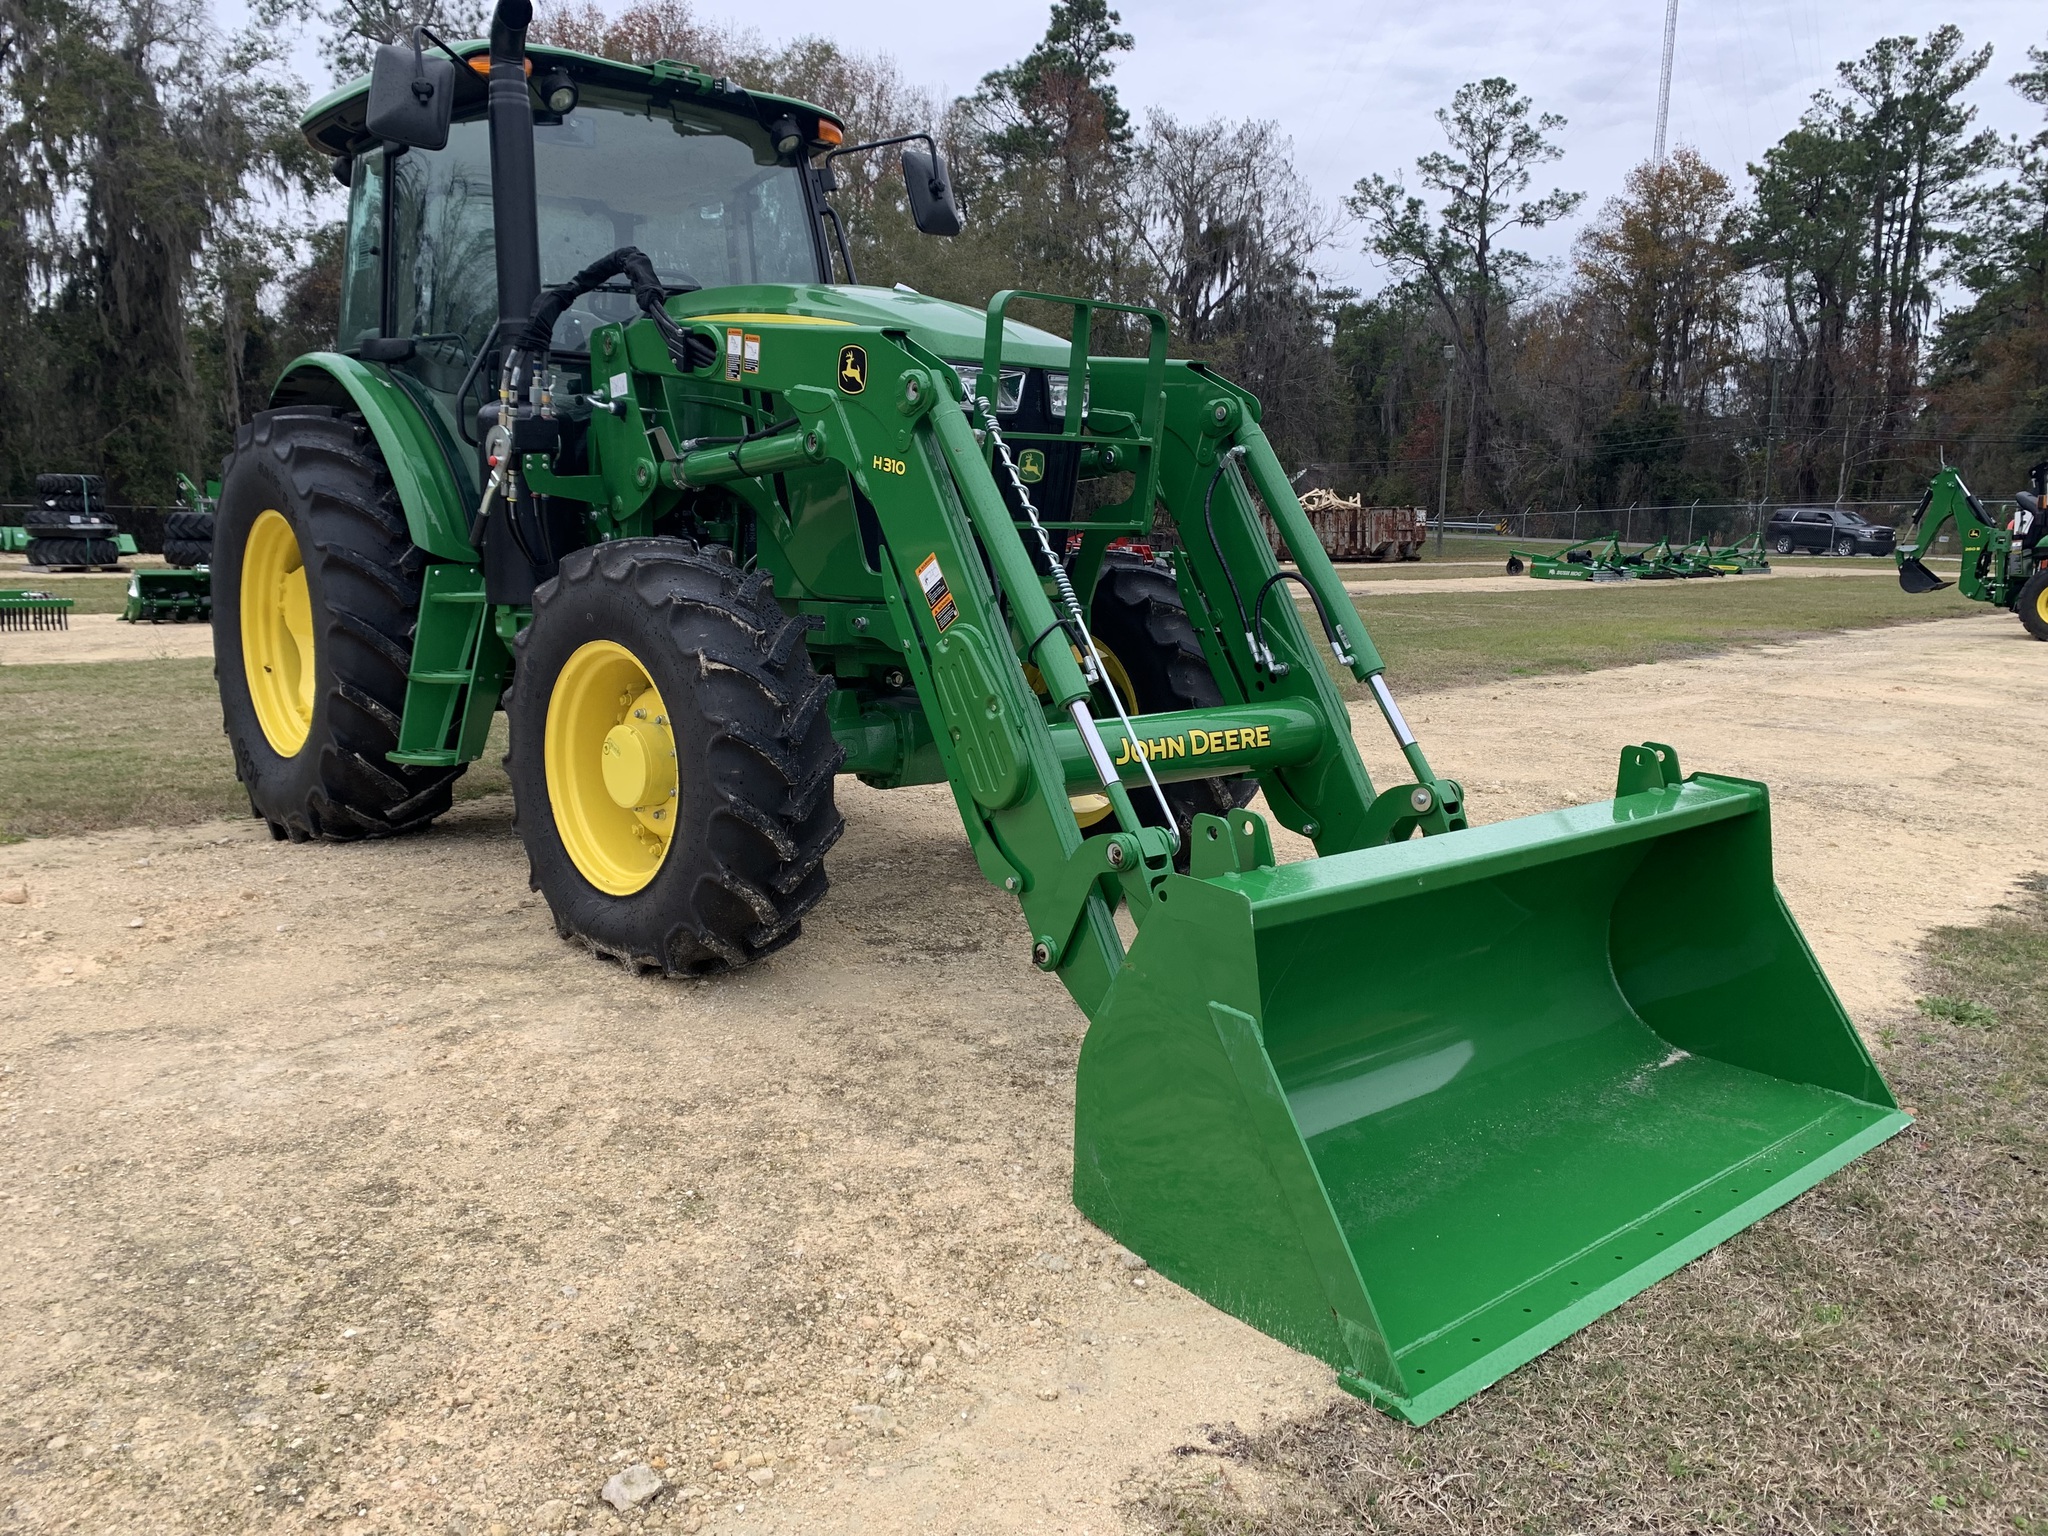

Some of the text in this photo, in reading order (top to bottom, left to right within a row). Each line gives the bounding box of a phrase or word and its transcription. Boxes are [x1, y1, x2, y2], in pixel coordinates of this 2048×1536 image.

[872, 454, 906, 476] H310
[1115, 725, 1271, 766] JOHN DEERE
